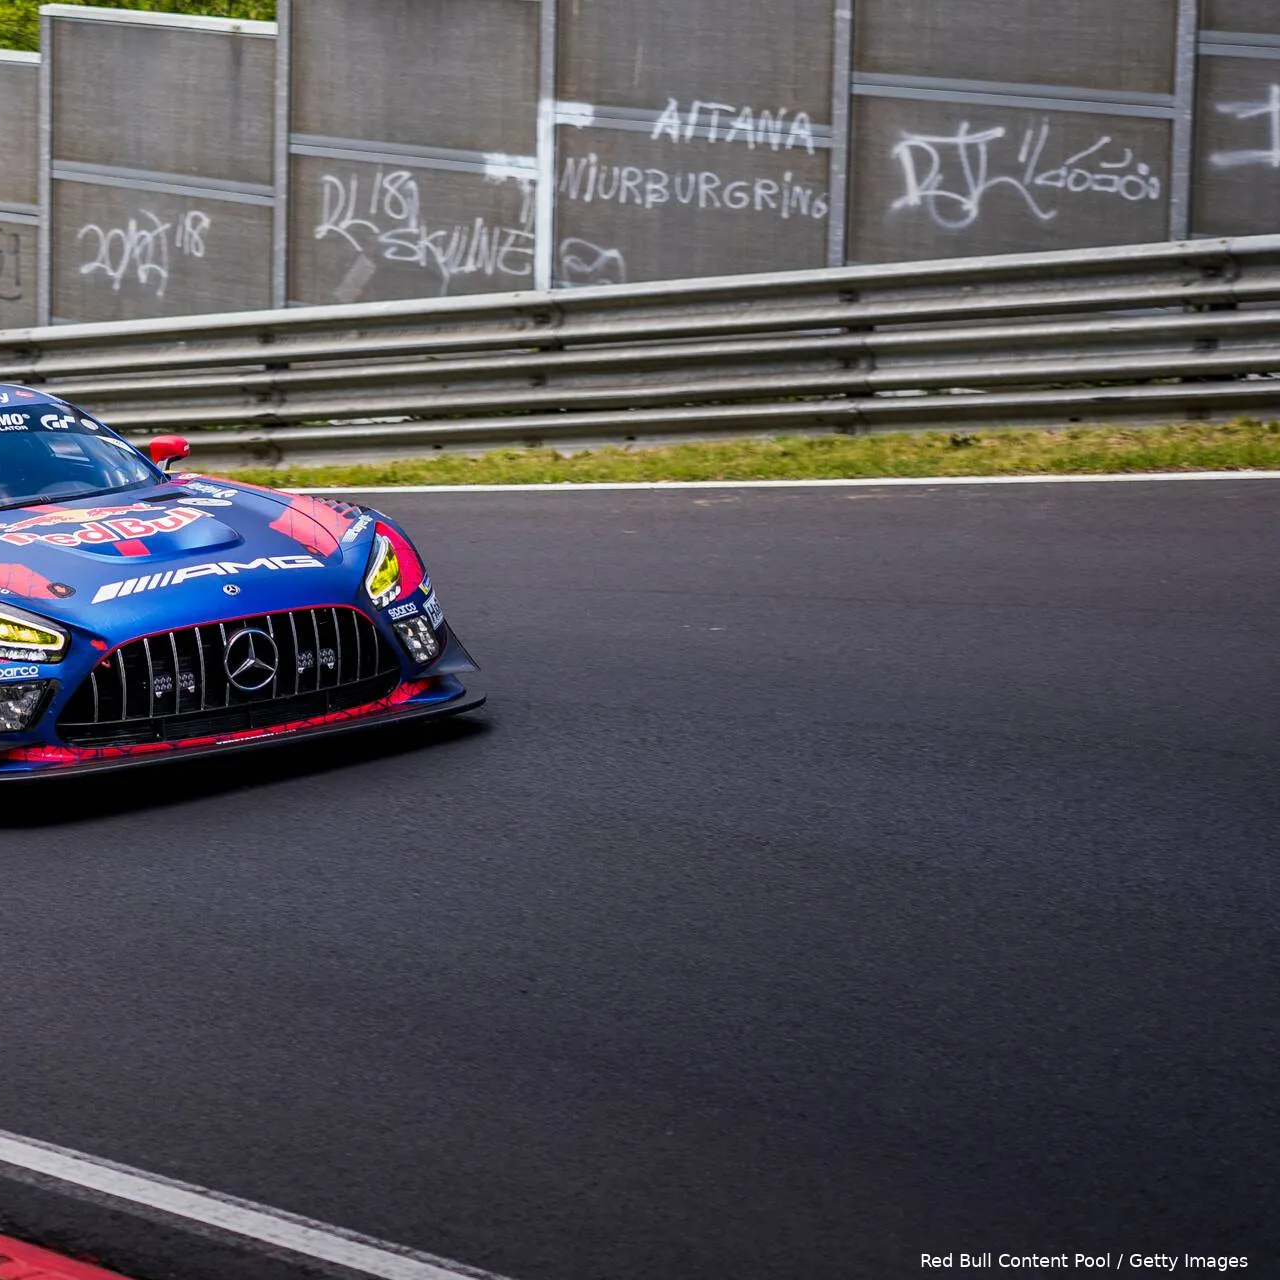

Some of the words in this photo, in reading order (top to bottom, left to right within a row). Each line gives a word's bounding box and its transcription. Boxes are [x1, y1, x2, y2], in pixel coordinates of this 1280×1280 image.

[105, 502, 215, 540] Bull
[173, 555, 325, 584] AMG
[388, 602, 418, 619] sparco
